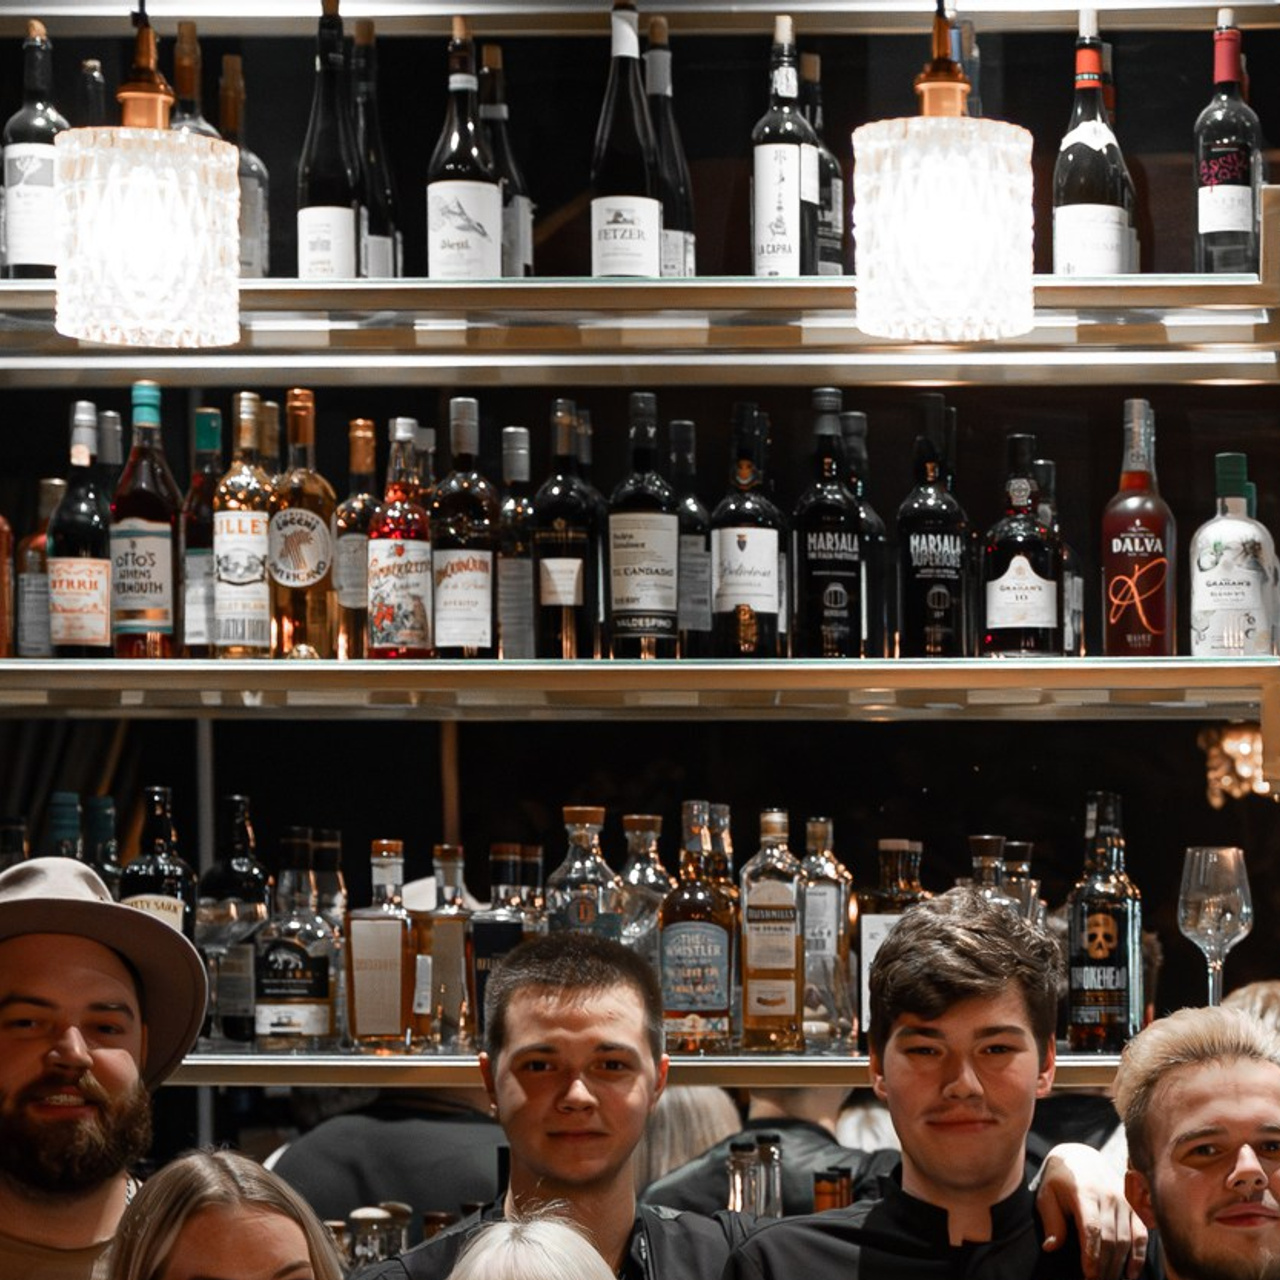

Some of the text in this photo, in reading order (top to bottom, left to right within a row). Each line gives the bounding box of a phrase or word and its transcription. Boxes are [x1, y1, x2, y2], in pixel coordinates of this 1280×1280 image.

[807, 532, 860, 552] MARSALA
[909, 533, 962, 554] MARSALA
[1111, 538, 1163, 553] DALVA
